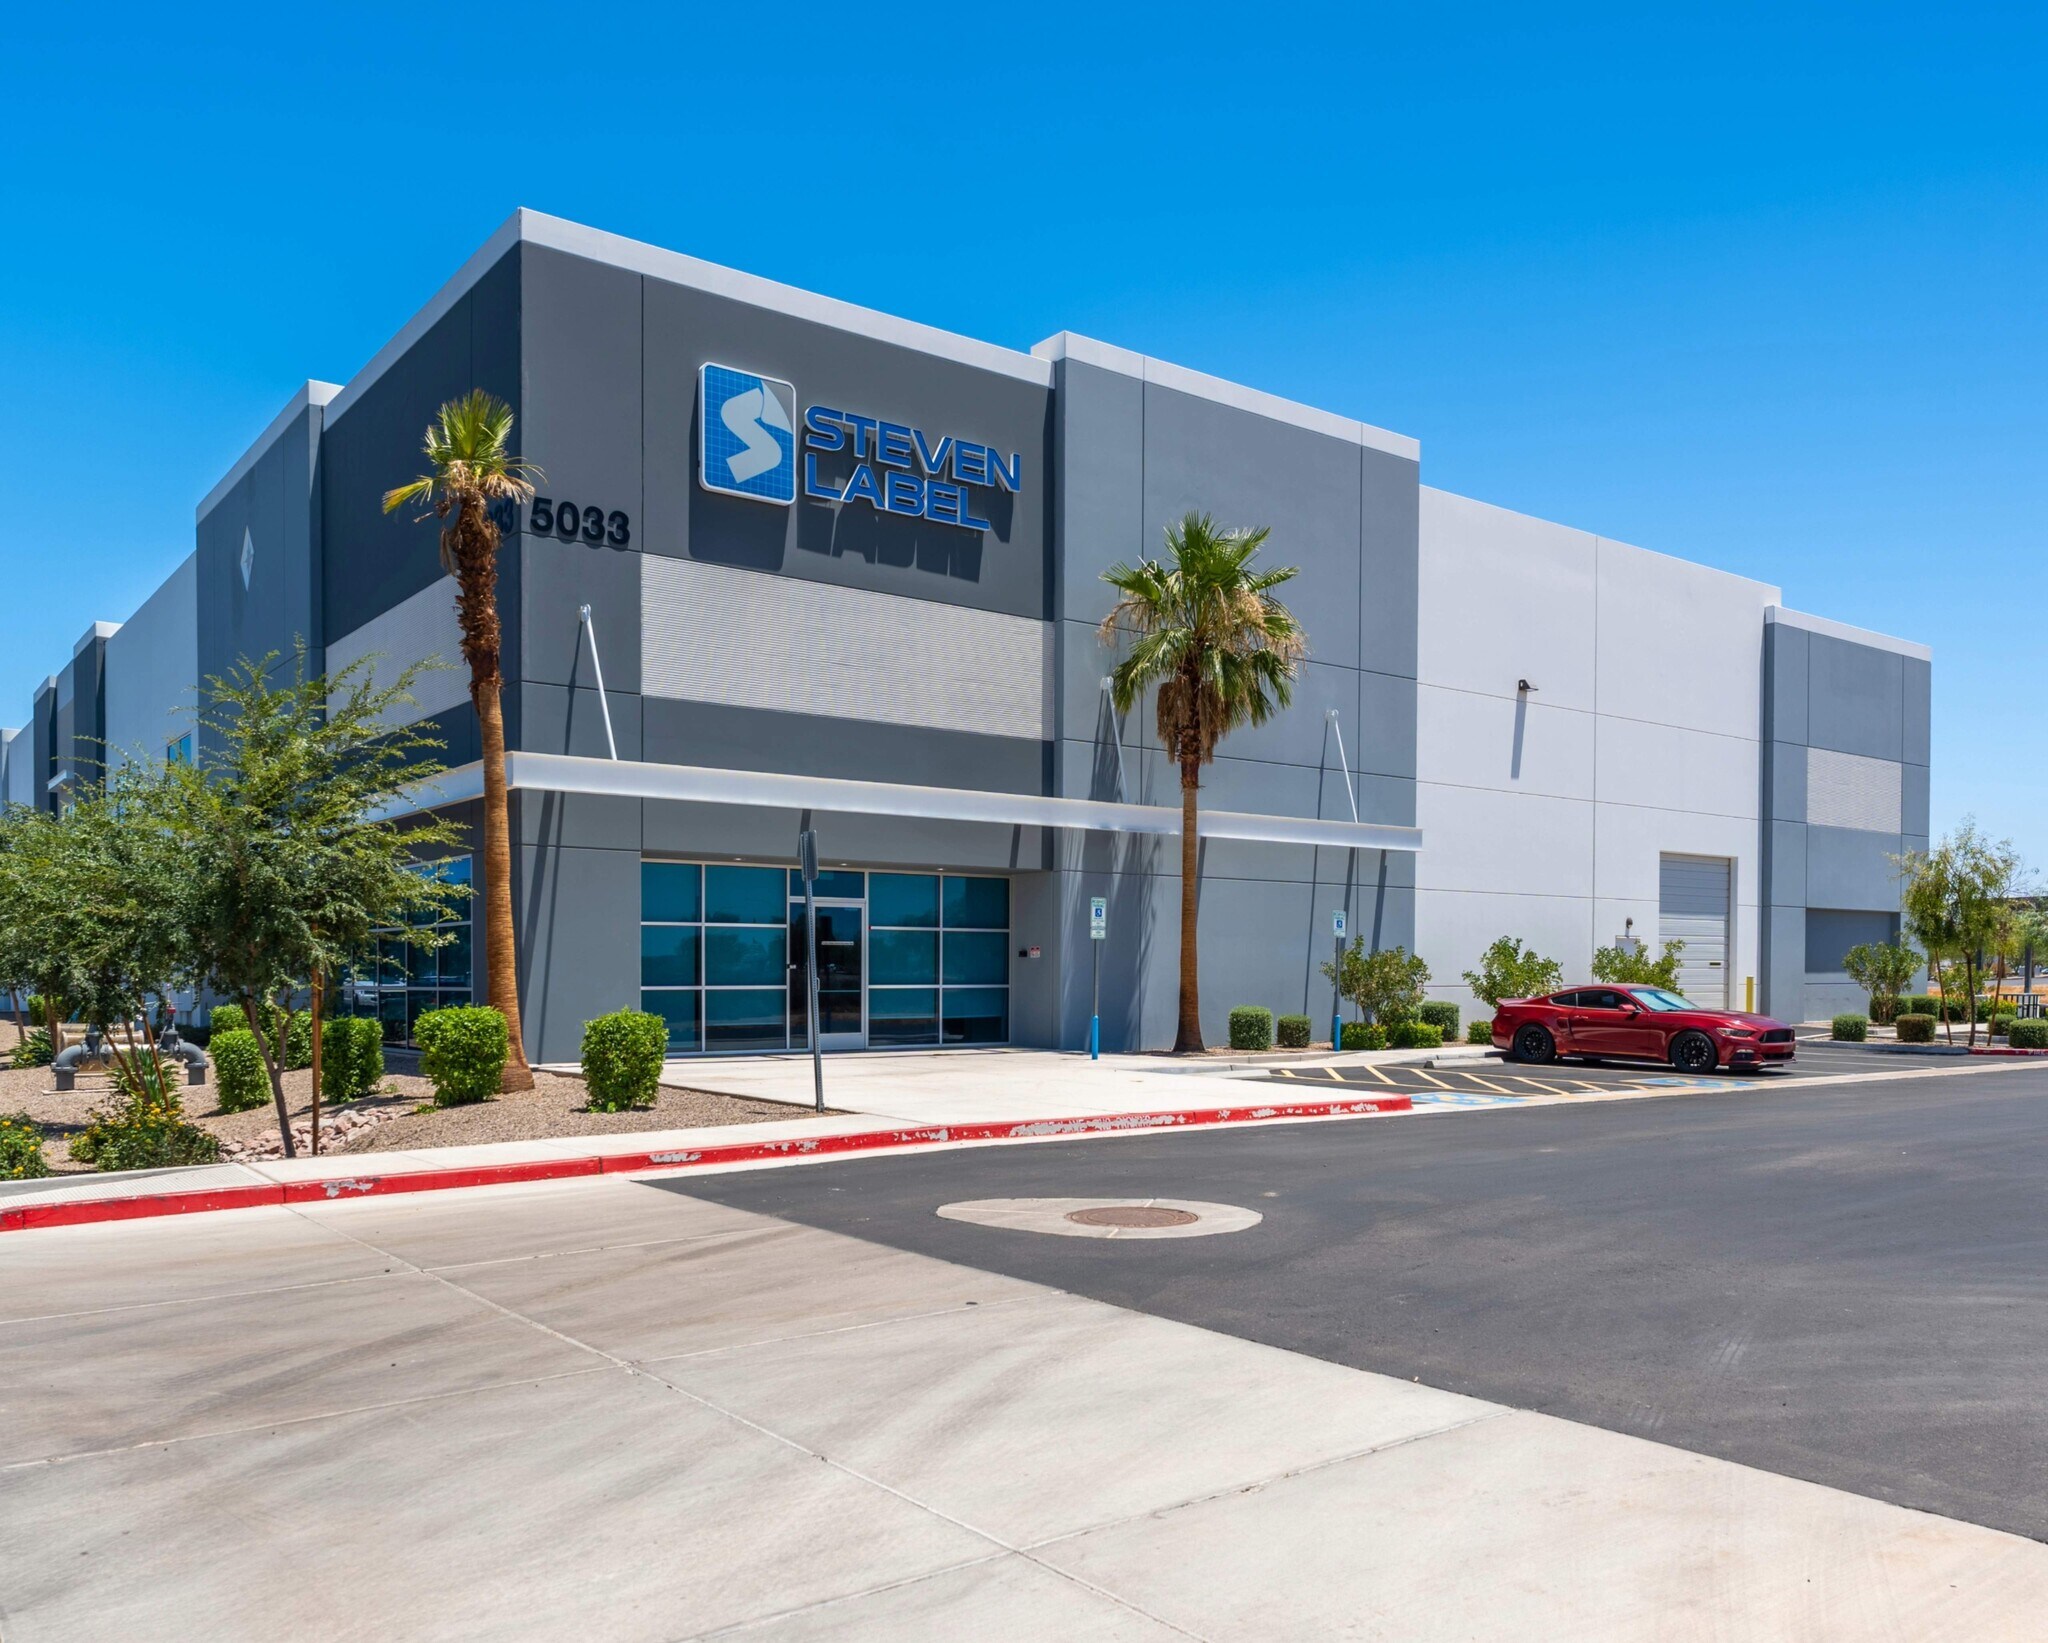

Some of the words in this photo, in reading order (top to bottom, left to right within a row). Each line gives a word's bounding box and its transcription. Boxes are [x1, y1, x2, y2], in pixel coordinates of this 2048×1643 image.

[805, 405, 1021, 493] STEVEN
[530, 497, 630, 545] 5033
[804, 452, 990, 531] LABEL
